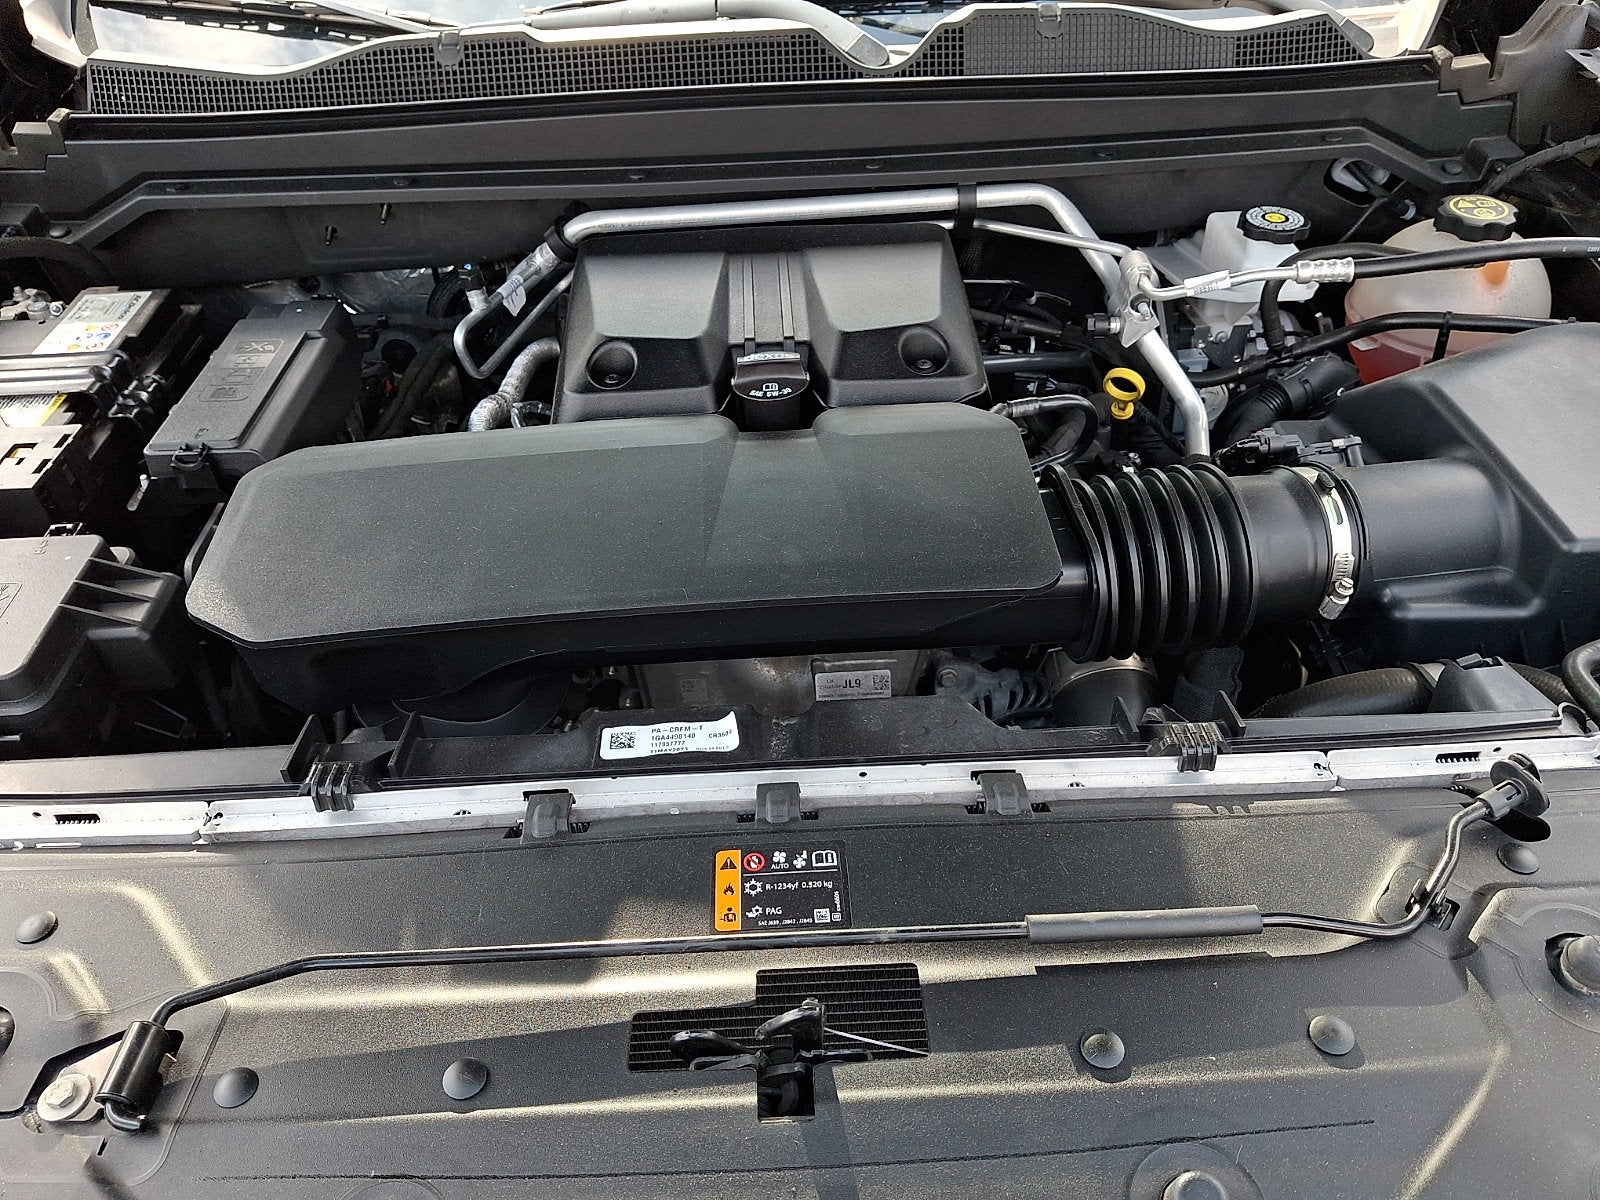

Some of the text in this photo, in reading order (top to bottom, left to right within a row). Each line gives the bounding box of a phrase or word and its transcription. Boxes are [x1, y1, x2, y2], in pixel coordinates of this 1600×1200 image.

[749, 389, 764, 397] SAE
[842, 678, 861, 689] JL9
[765, 880, 833, 891] R-1234yf 0.520 kg
[765, 907, 782, 915] PAG
